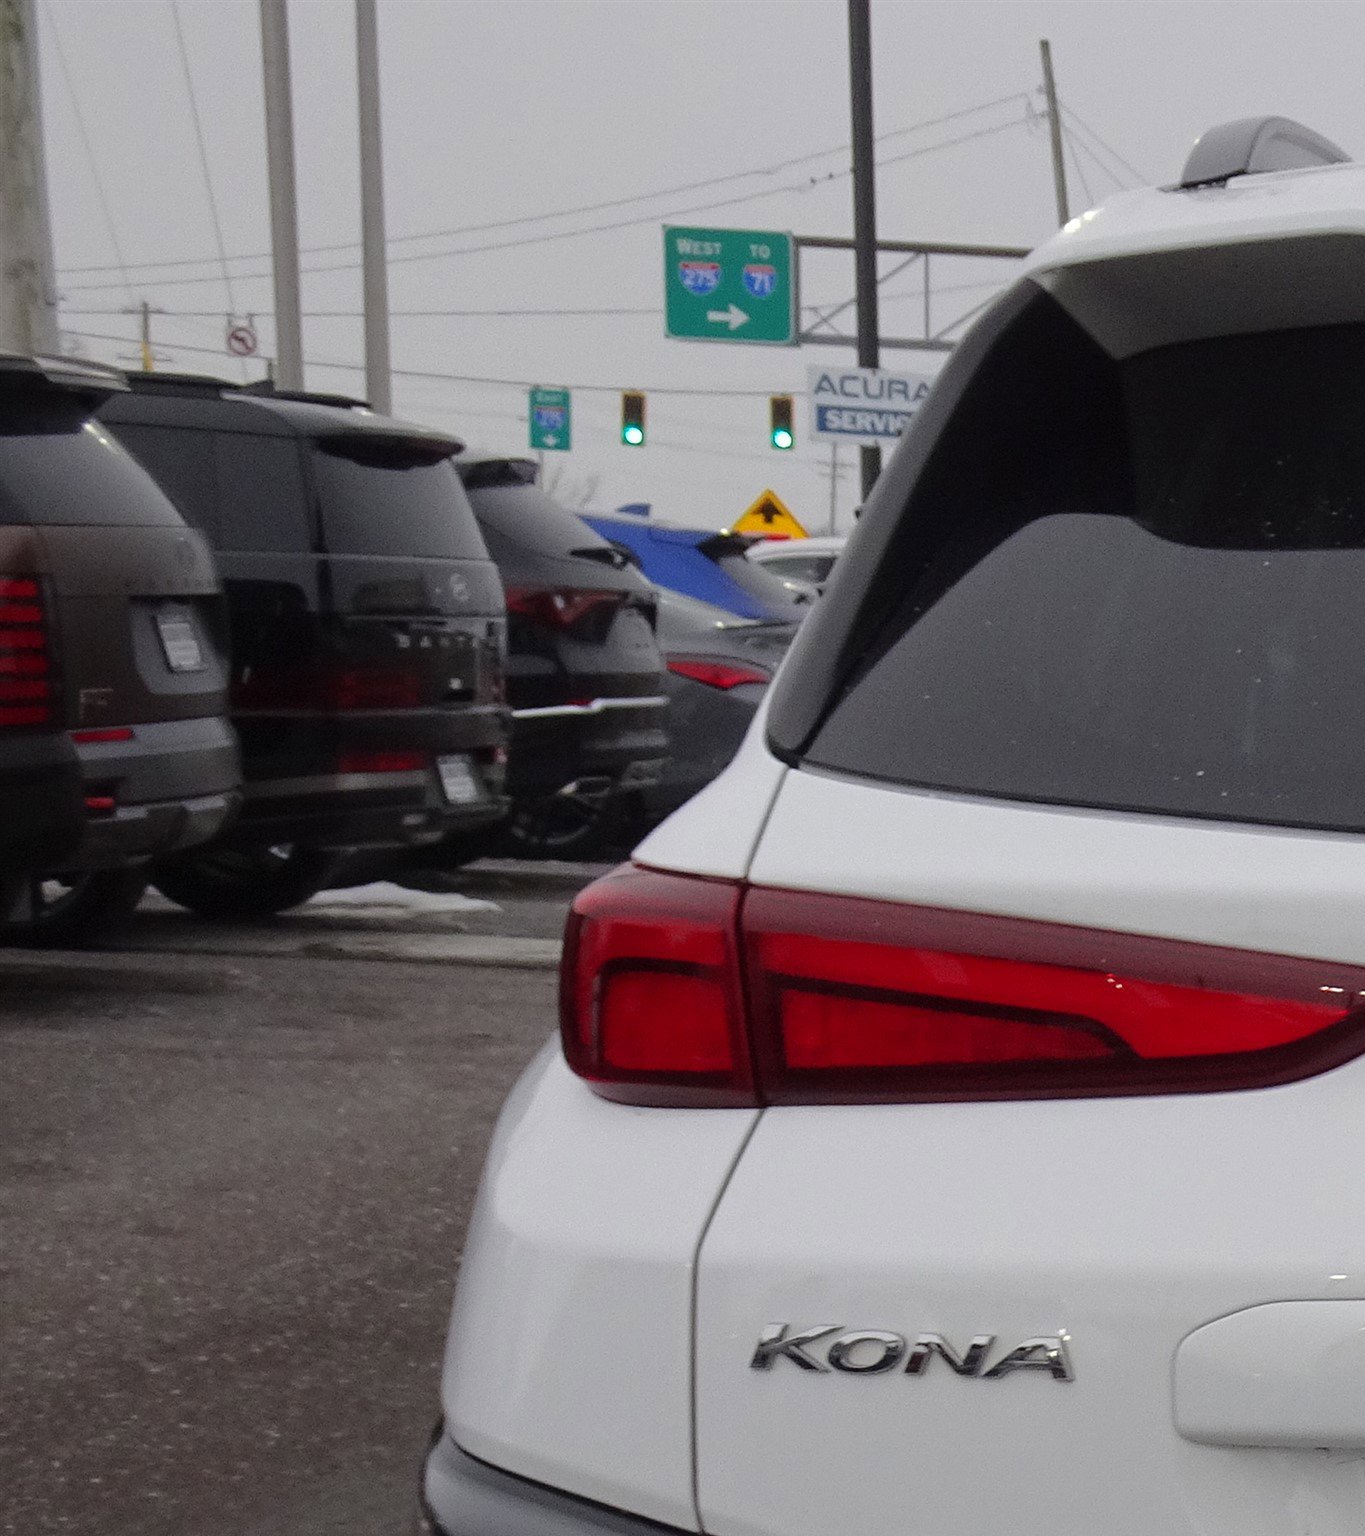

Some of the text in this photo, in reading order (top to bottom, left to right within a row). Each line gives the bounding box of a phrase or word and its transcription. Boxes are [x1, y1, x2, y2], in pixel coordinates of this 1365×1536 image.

[677, 238, 771, 260] WEST TO
[750, 271, 771, 292] 71
[814, 373, 930, 402] ACURA
[750, 1321, 1076, 1382] KONA
